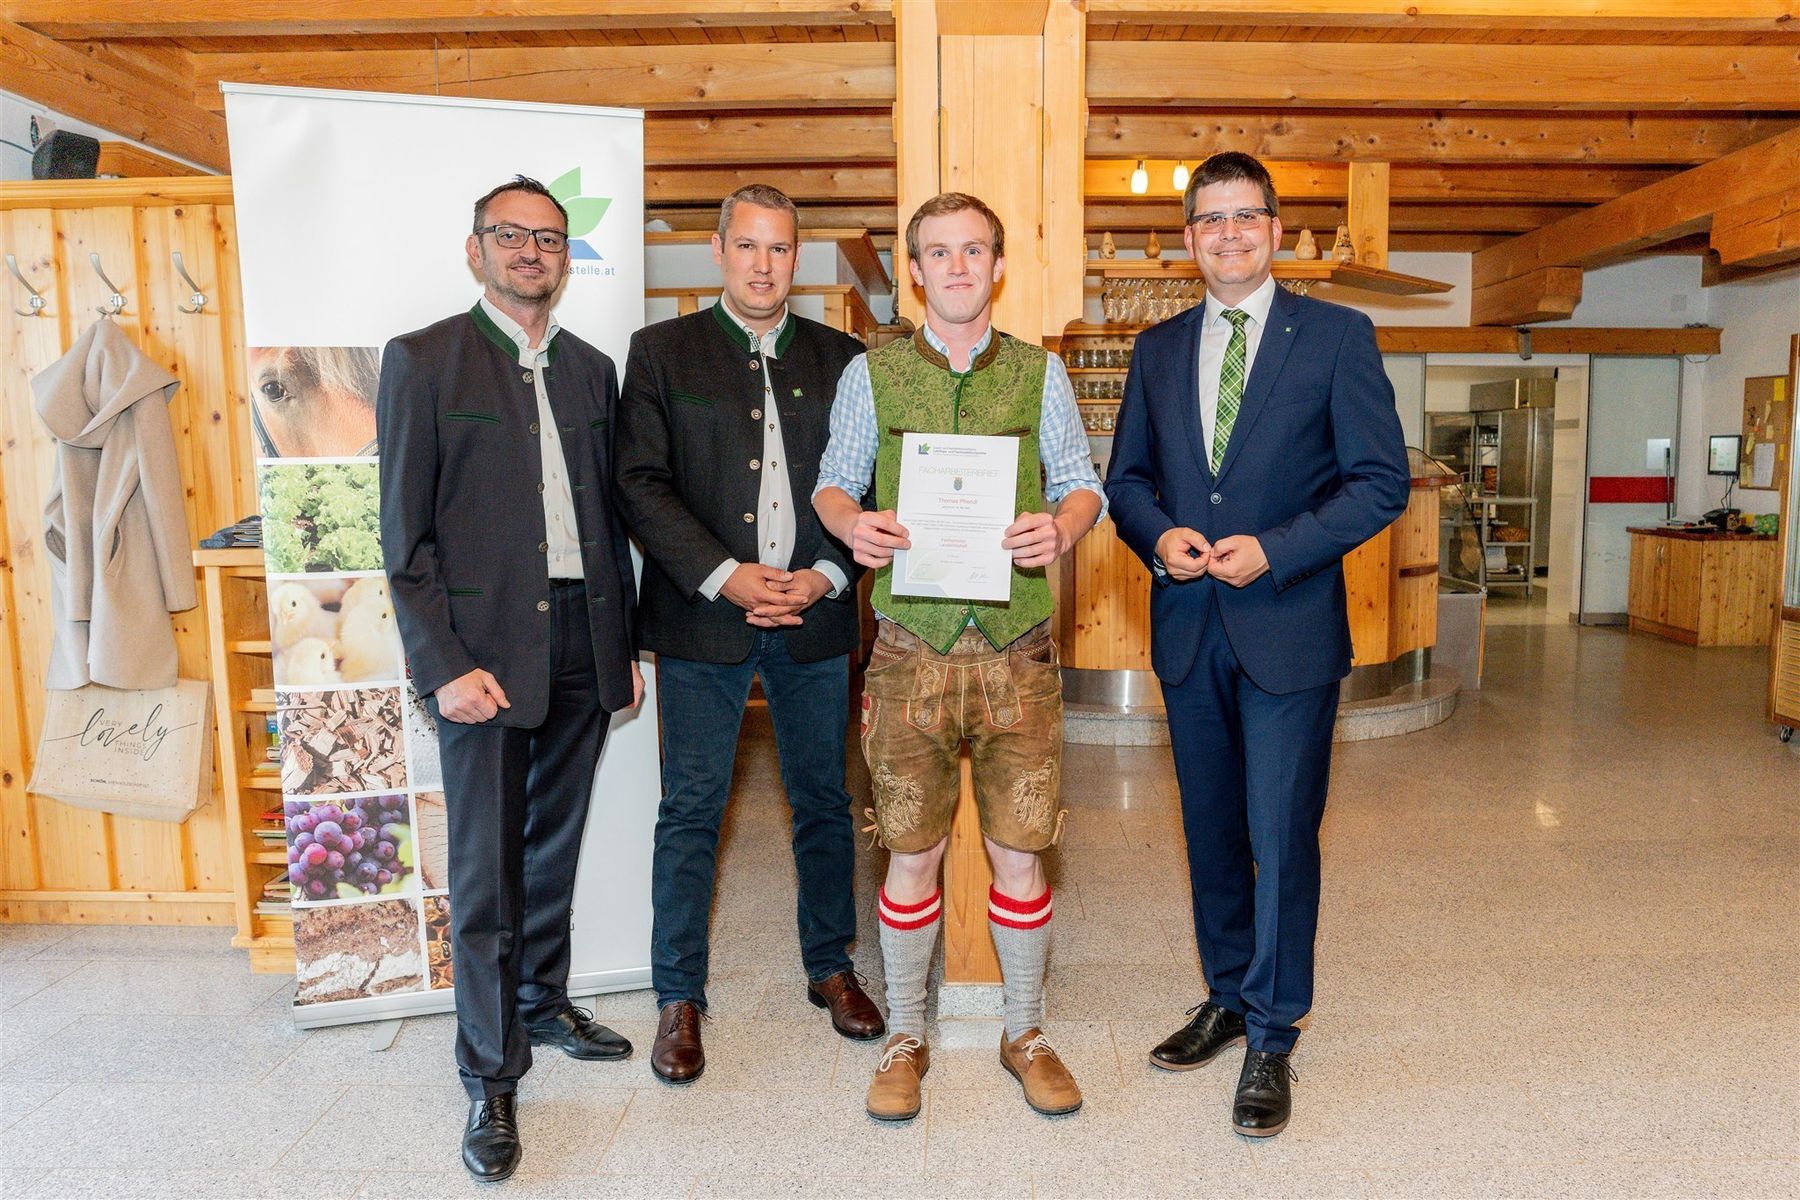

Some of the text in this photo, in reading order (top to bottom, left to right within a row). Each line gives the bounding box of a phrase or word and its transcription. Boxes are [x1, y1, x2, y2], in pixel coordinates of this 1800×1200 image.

[567, 264, 616, 276] stelle.at
[99, 719, 123, 728] VERY
[45, 703, 198, 761] lovely
[114, 740, 147, 749] THINGS
[114, 748, 145, 756] INSIDE
